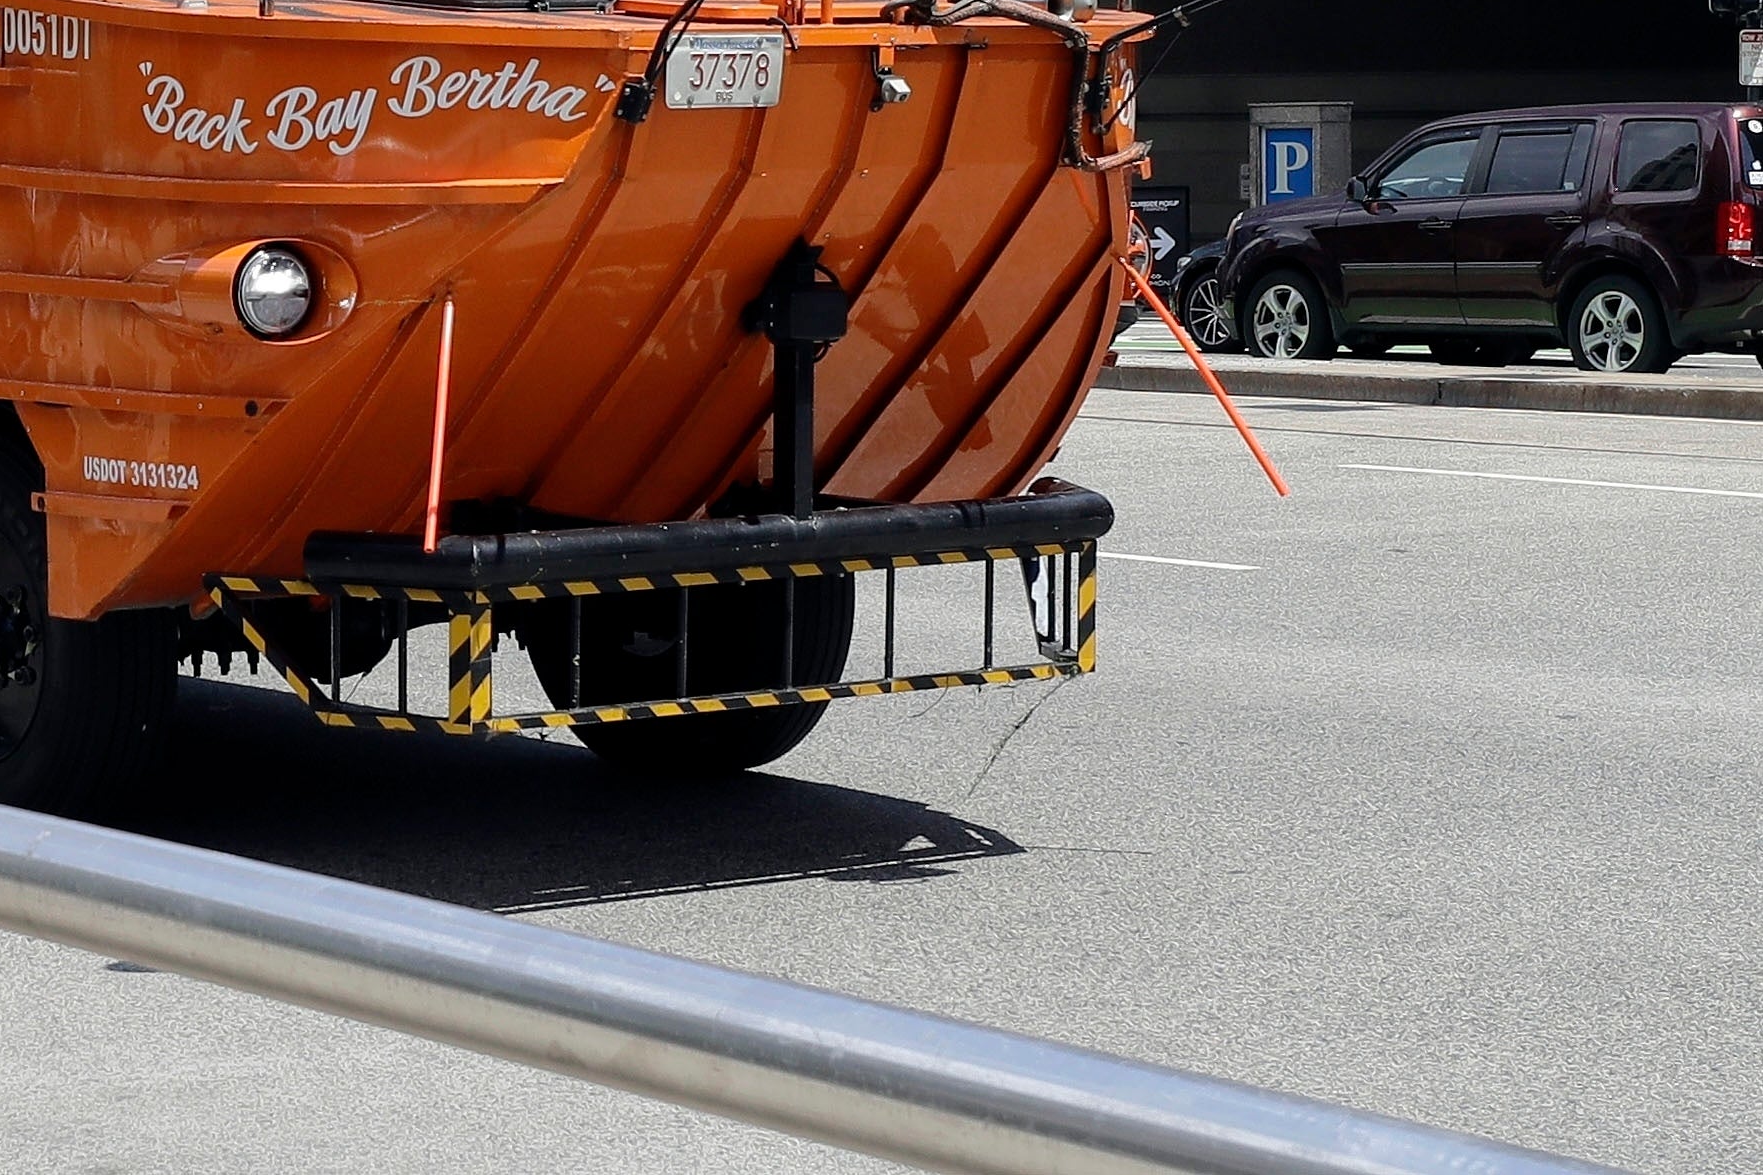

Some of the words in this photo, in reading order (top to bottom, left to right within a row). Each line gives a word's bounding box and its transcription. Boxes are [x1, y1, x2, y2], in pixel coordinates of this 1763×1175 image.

[689, 52, 770, 90] 37378
[716, 90, 734, 103] BUS
[266, 86, 377, 155] Bay
[1270, 141, 1309, 194] P
[84, 456, 126, 484] USDOT
[131, 461, 198, 490] 3131324
